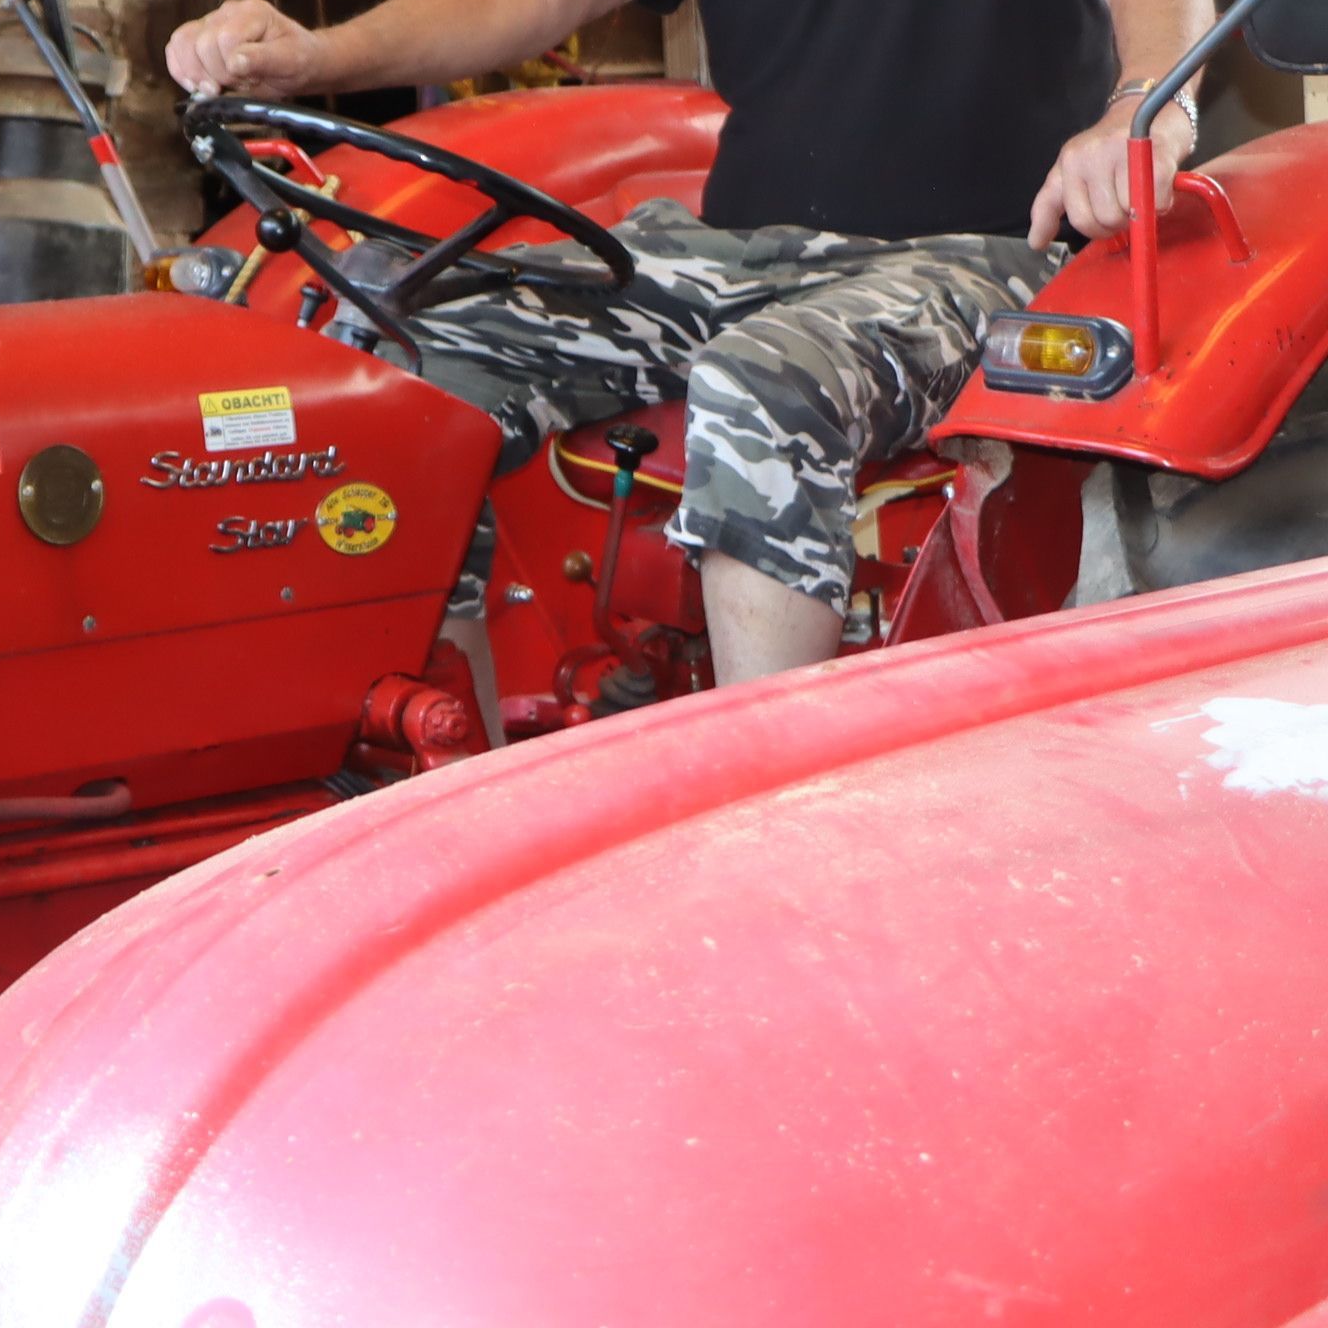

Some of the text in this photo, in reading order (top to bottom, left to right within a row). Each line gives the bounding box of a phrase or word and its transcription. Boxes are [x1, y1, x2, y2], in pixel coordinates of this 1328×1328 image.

[221, 393, 286, 411] OBACHT!
[140, 445, 346, 489] Standard
[208, 516, 308, 553] Star
